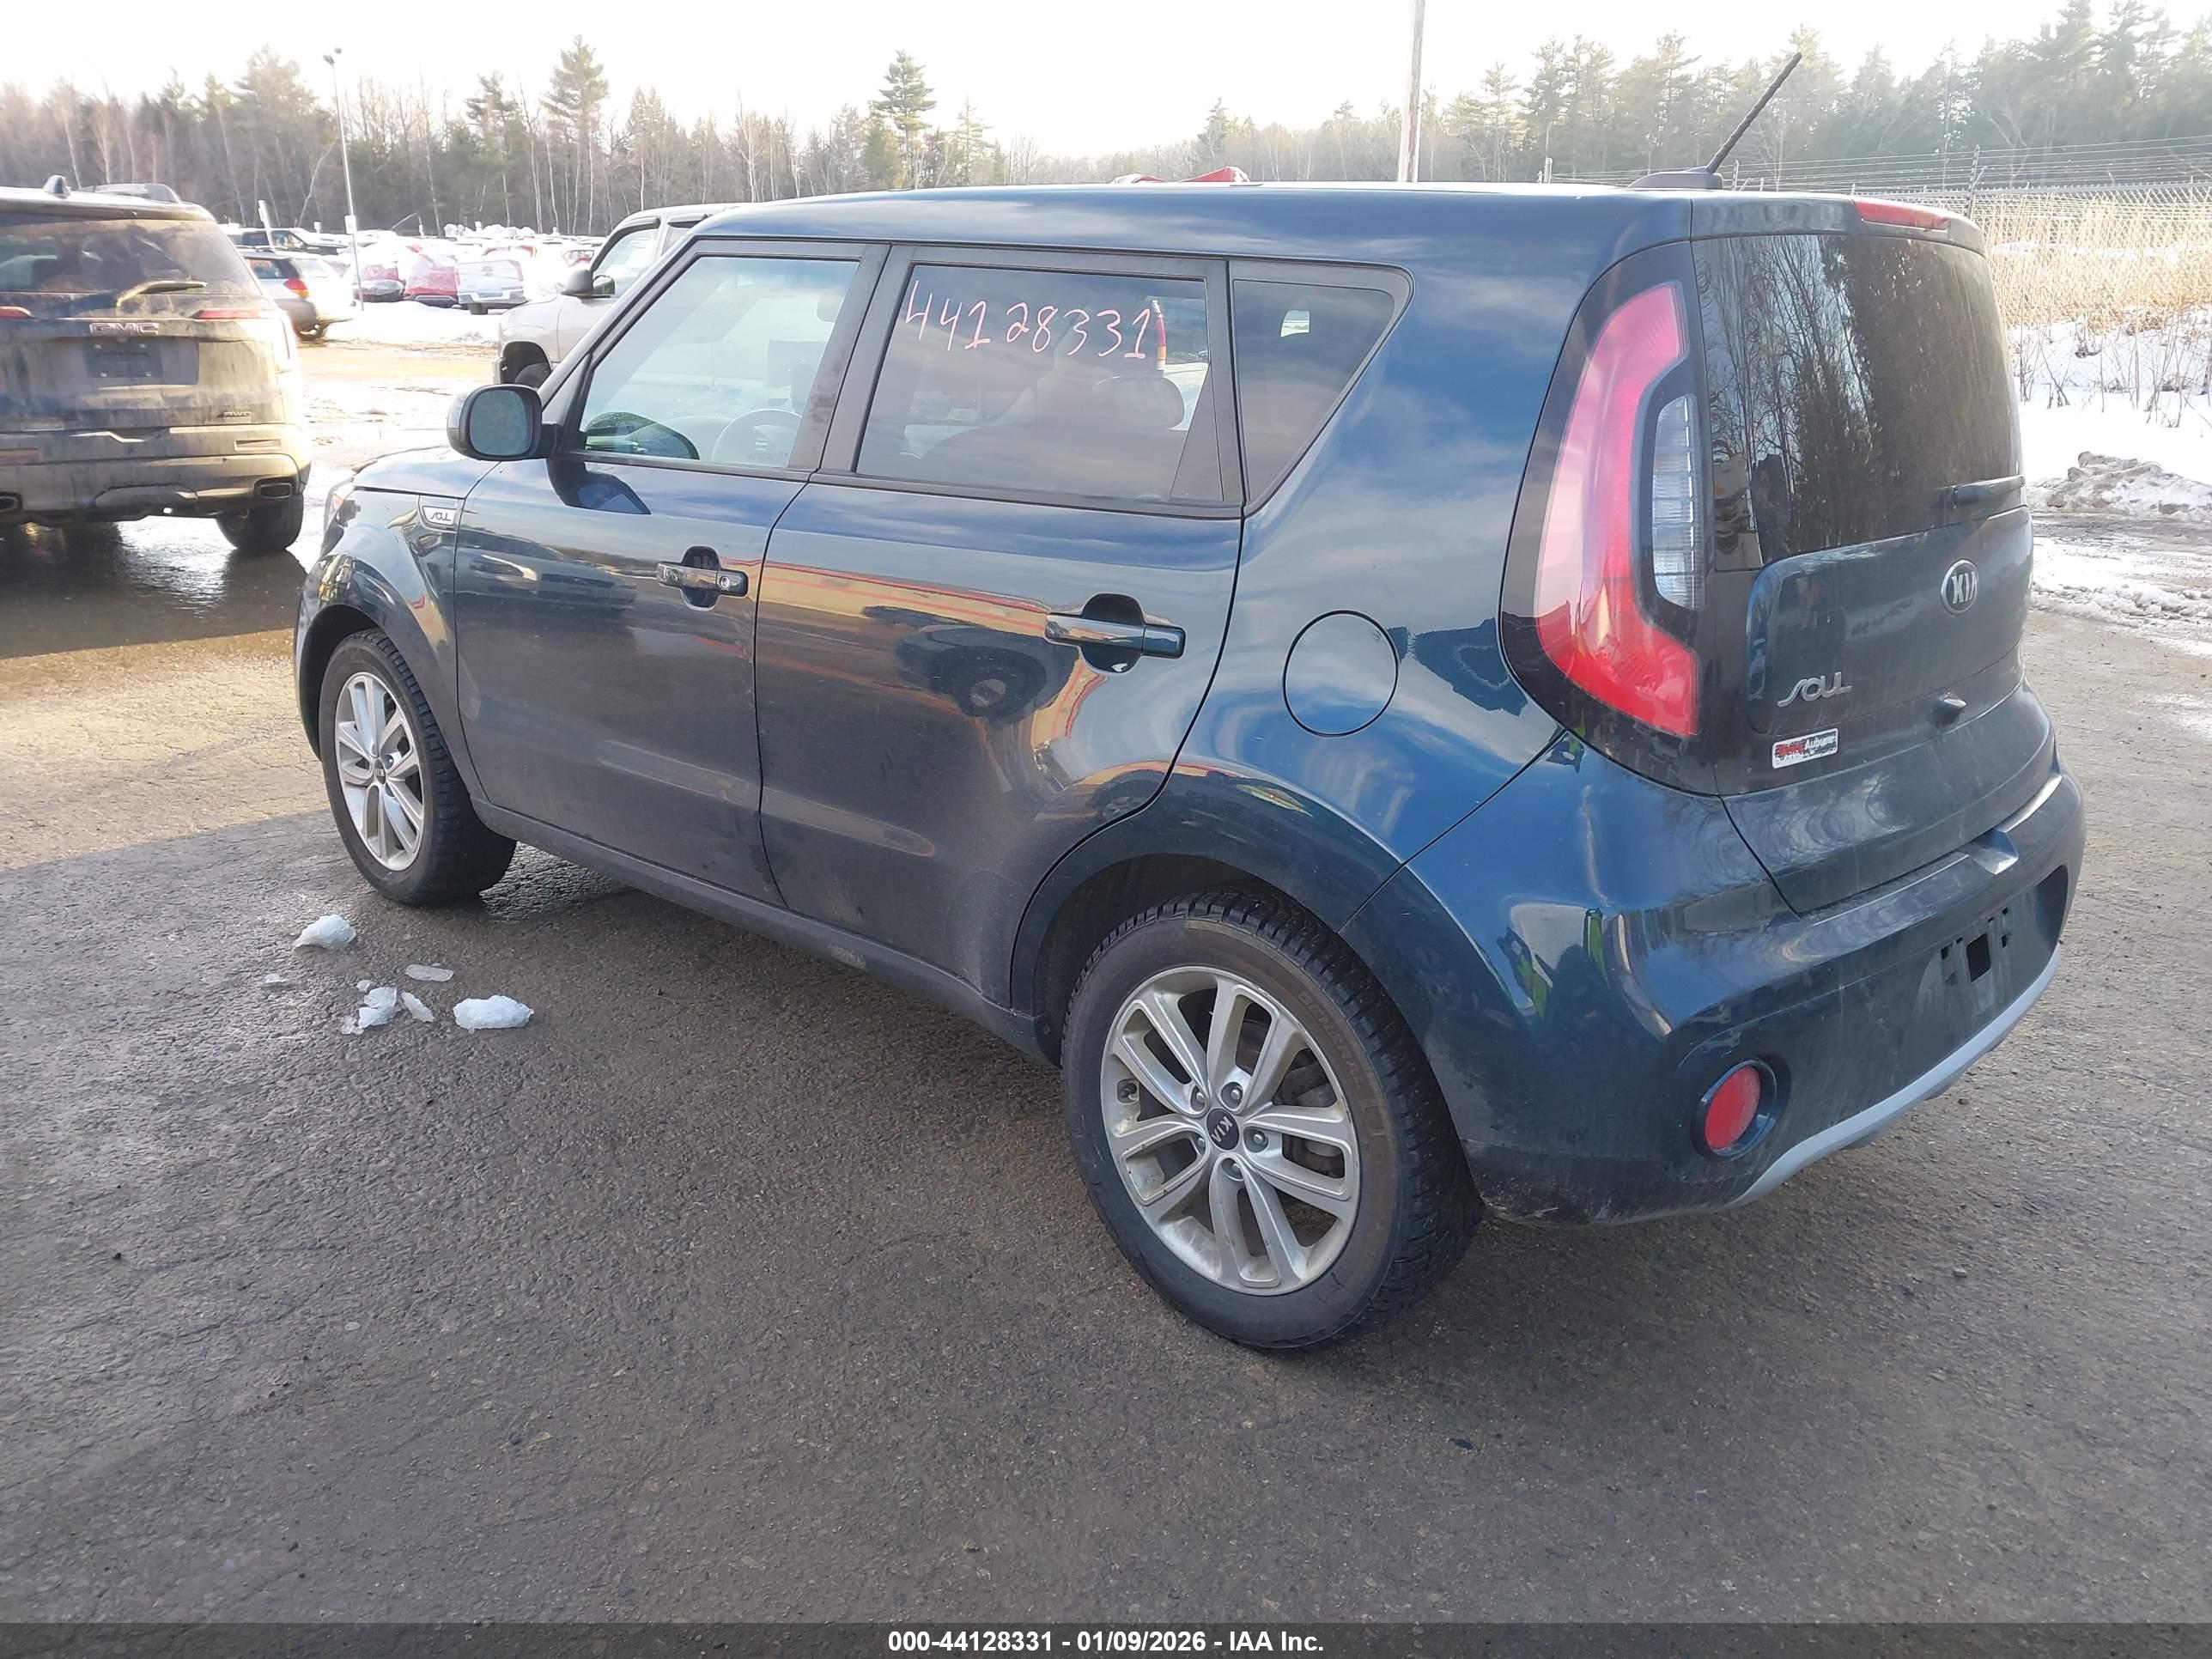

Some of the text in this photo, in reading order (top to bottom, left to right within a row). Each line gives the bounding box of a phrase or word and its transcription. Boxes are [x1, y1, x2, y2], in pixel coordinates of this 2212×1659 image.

[89, 322, 160, 336] GMC
[905, 280, 1151, 359] 44128331
[1951, 571, 1978, 605] KIA
[1777, 672, 1852, 708] SOUL
[1211, 1115, 1233, 1143] KIA
